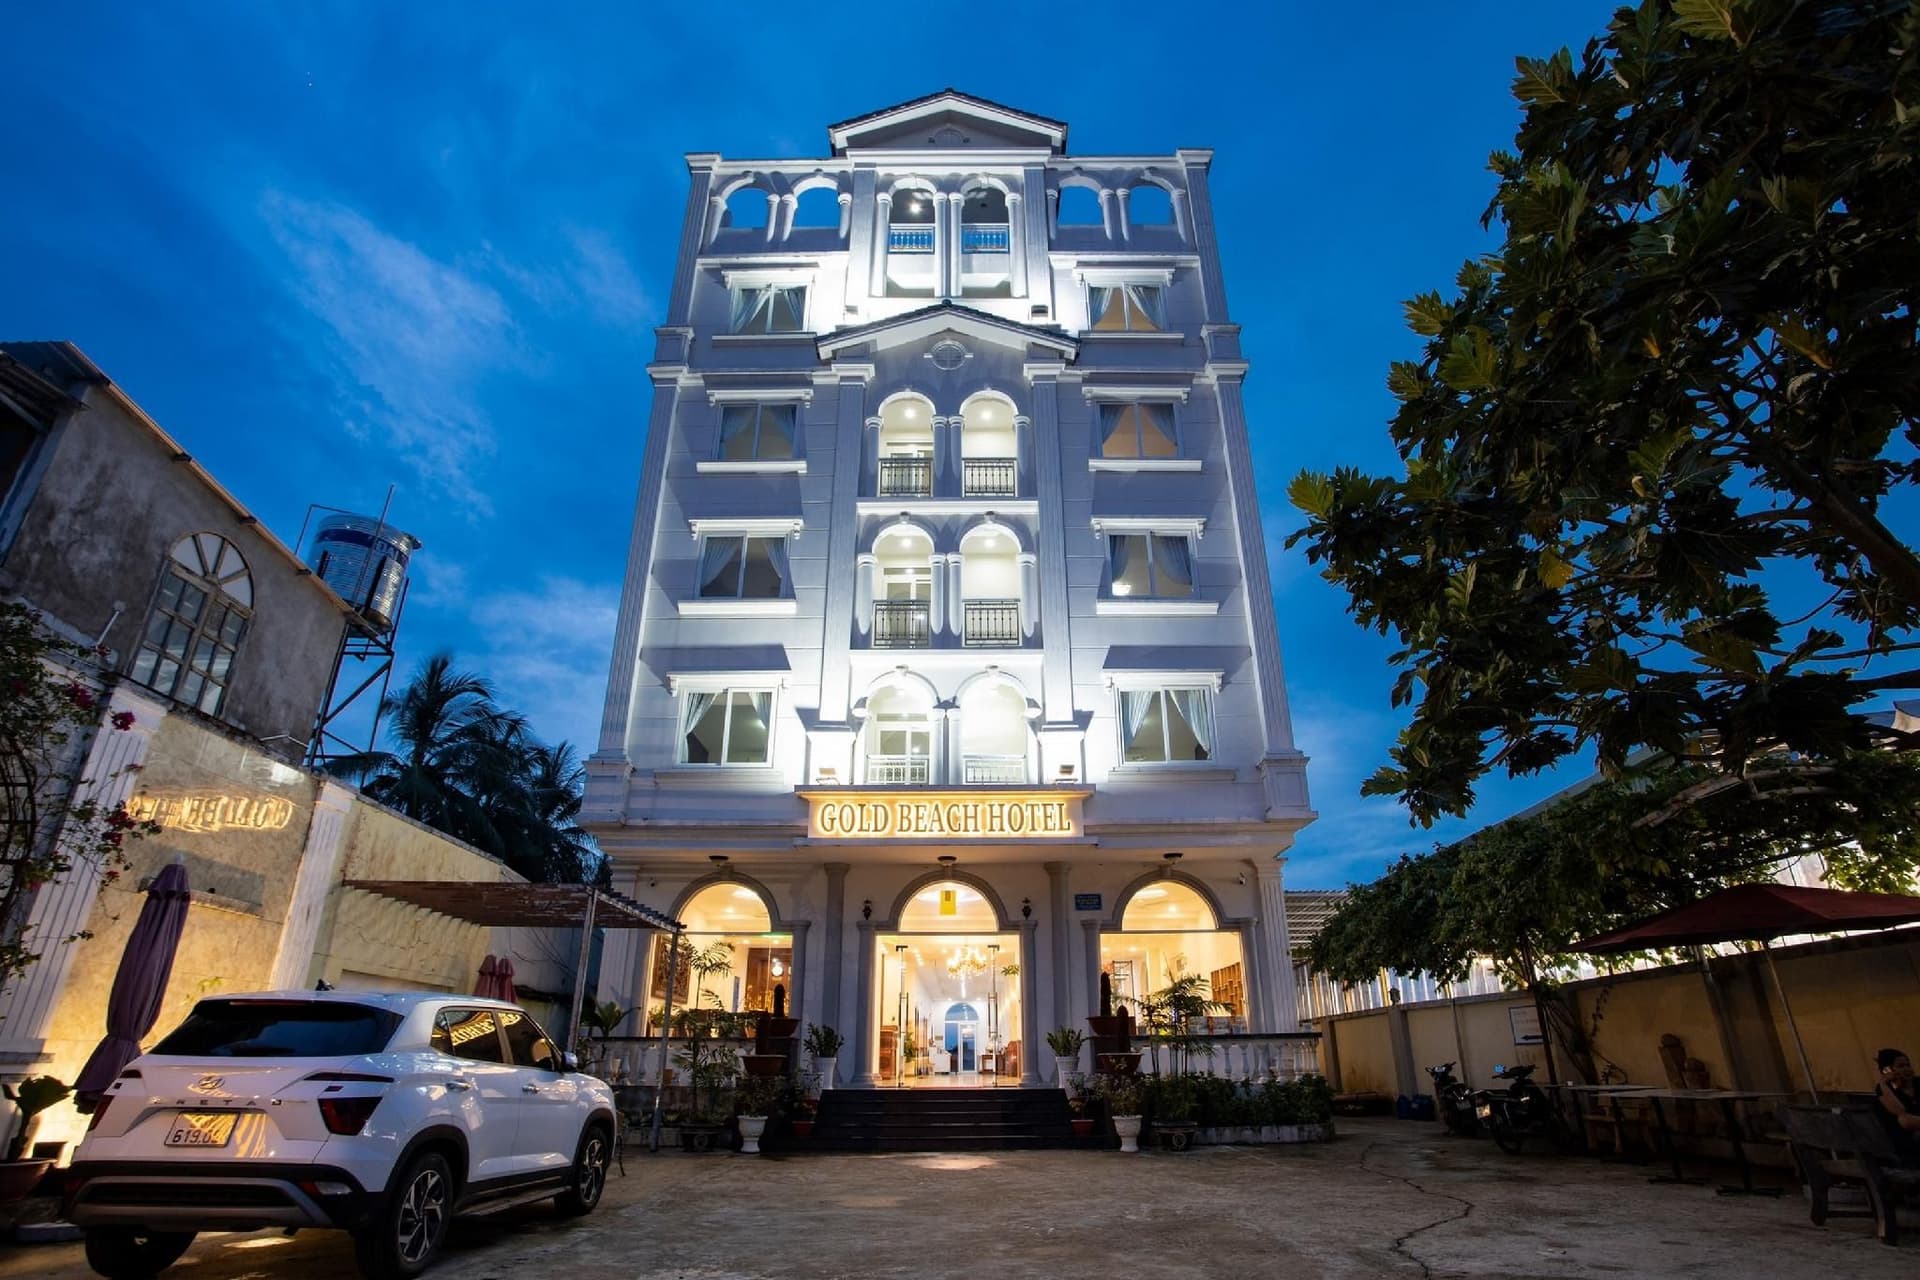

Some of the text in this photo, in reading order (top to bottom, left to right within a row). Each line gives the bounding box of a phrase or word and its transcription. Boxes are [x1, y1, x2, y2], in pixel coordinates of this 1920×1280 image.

[821, 802, 1071, 833] GOLD BEACH HOTEL
